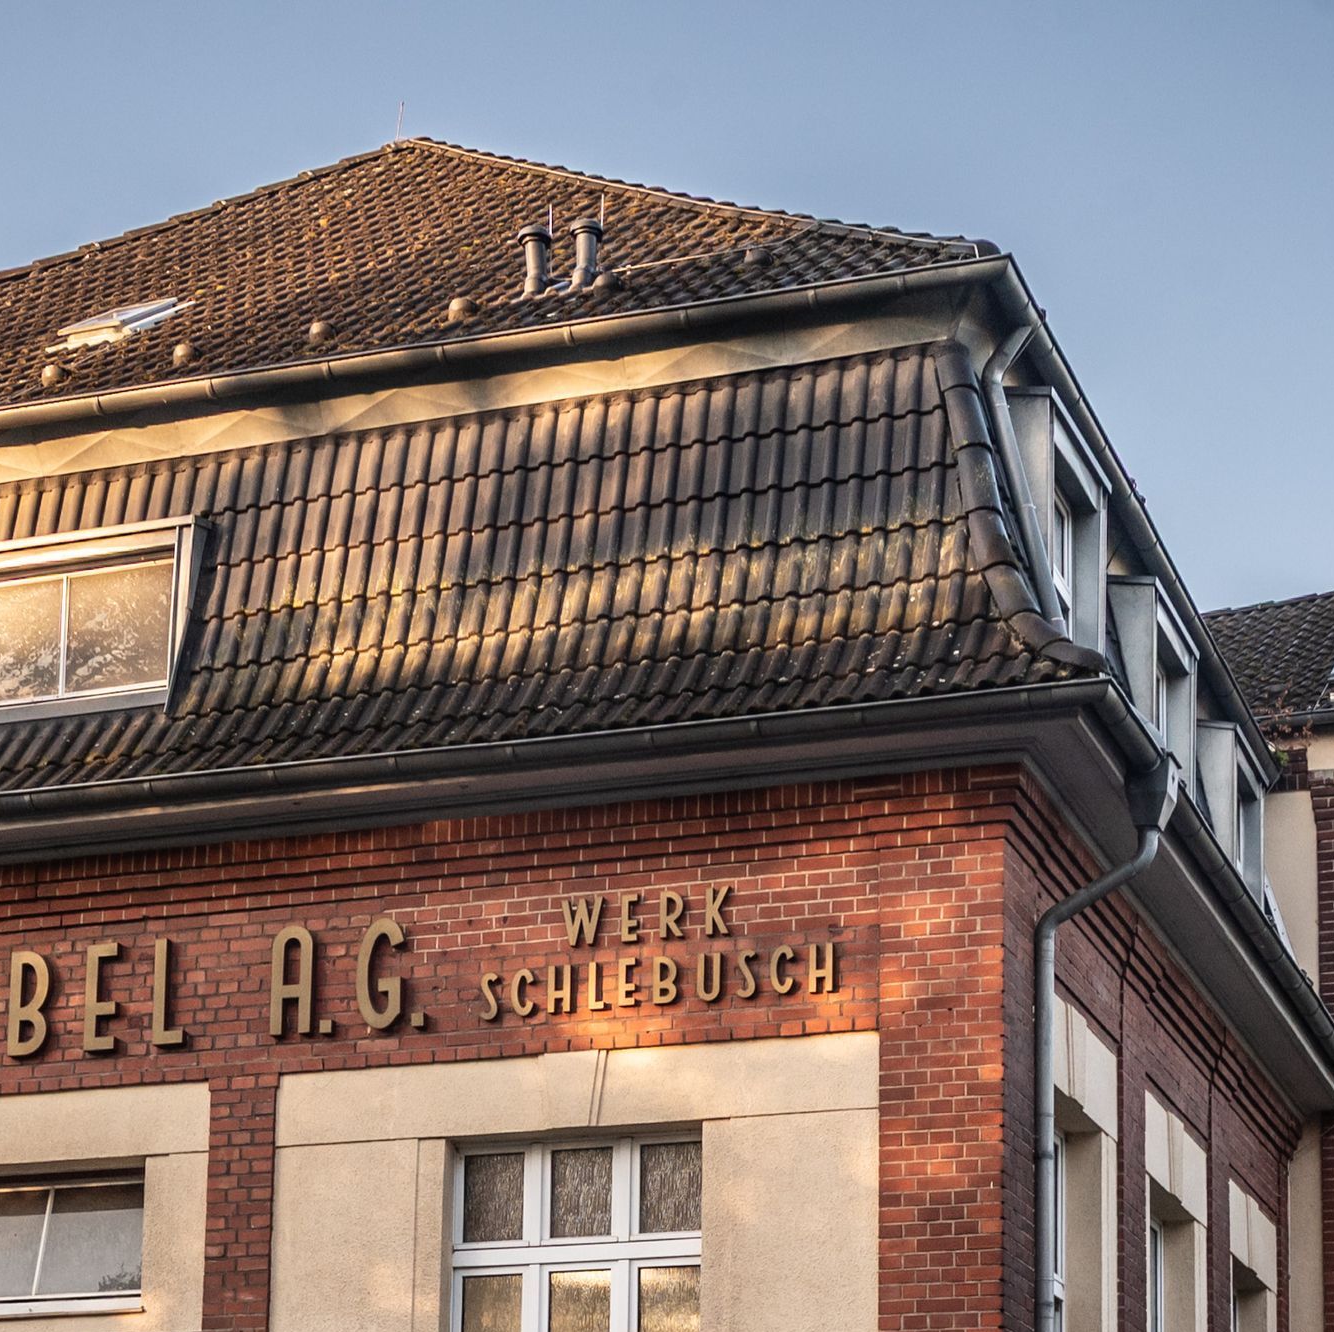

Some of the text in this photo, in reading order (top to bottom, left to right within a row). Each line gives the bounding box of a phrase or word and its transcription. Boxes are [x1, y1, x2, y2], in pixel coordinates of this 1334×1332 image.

[561, 885, 734, 948] WERK
[269, 918, 426, 1037] A.G.
[478, 942, 840, 1021] SCHLEBUSCH
